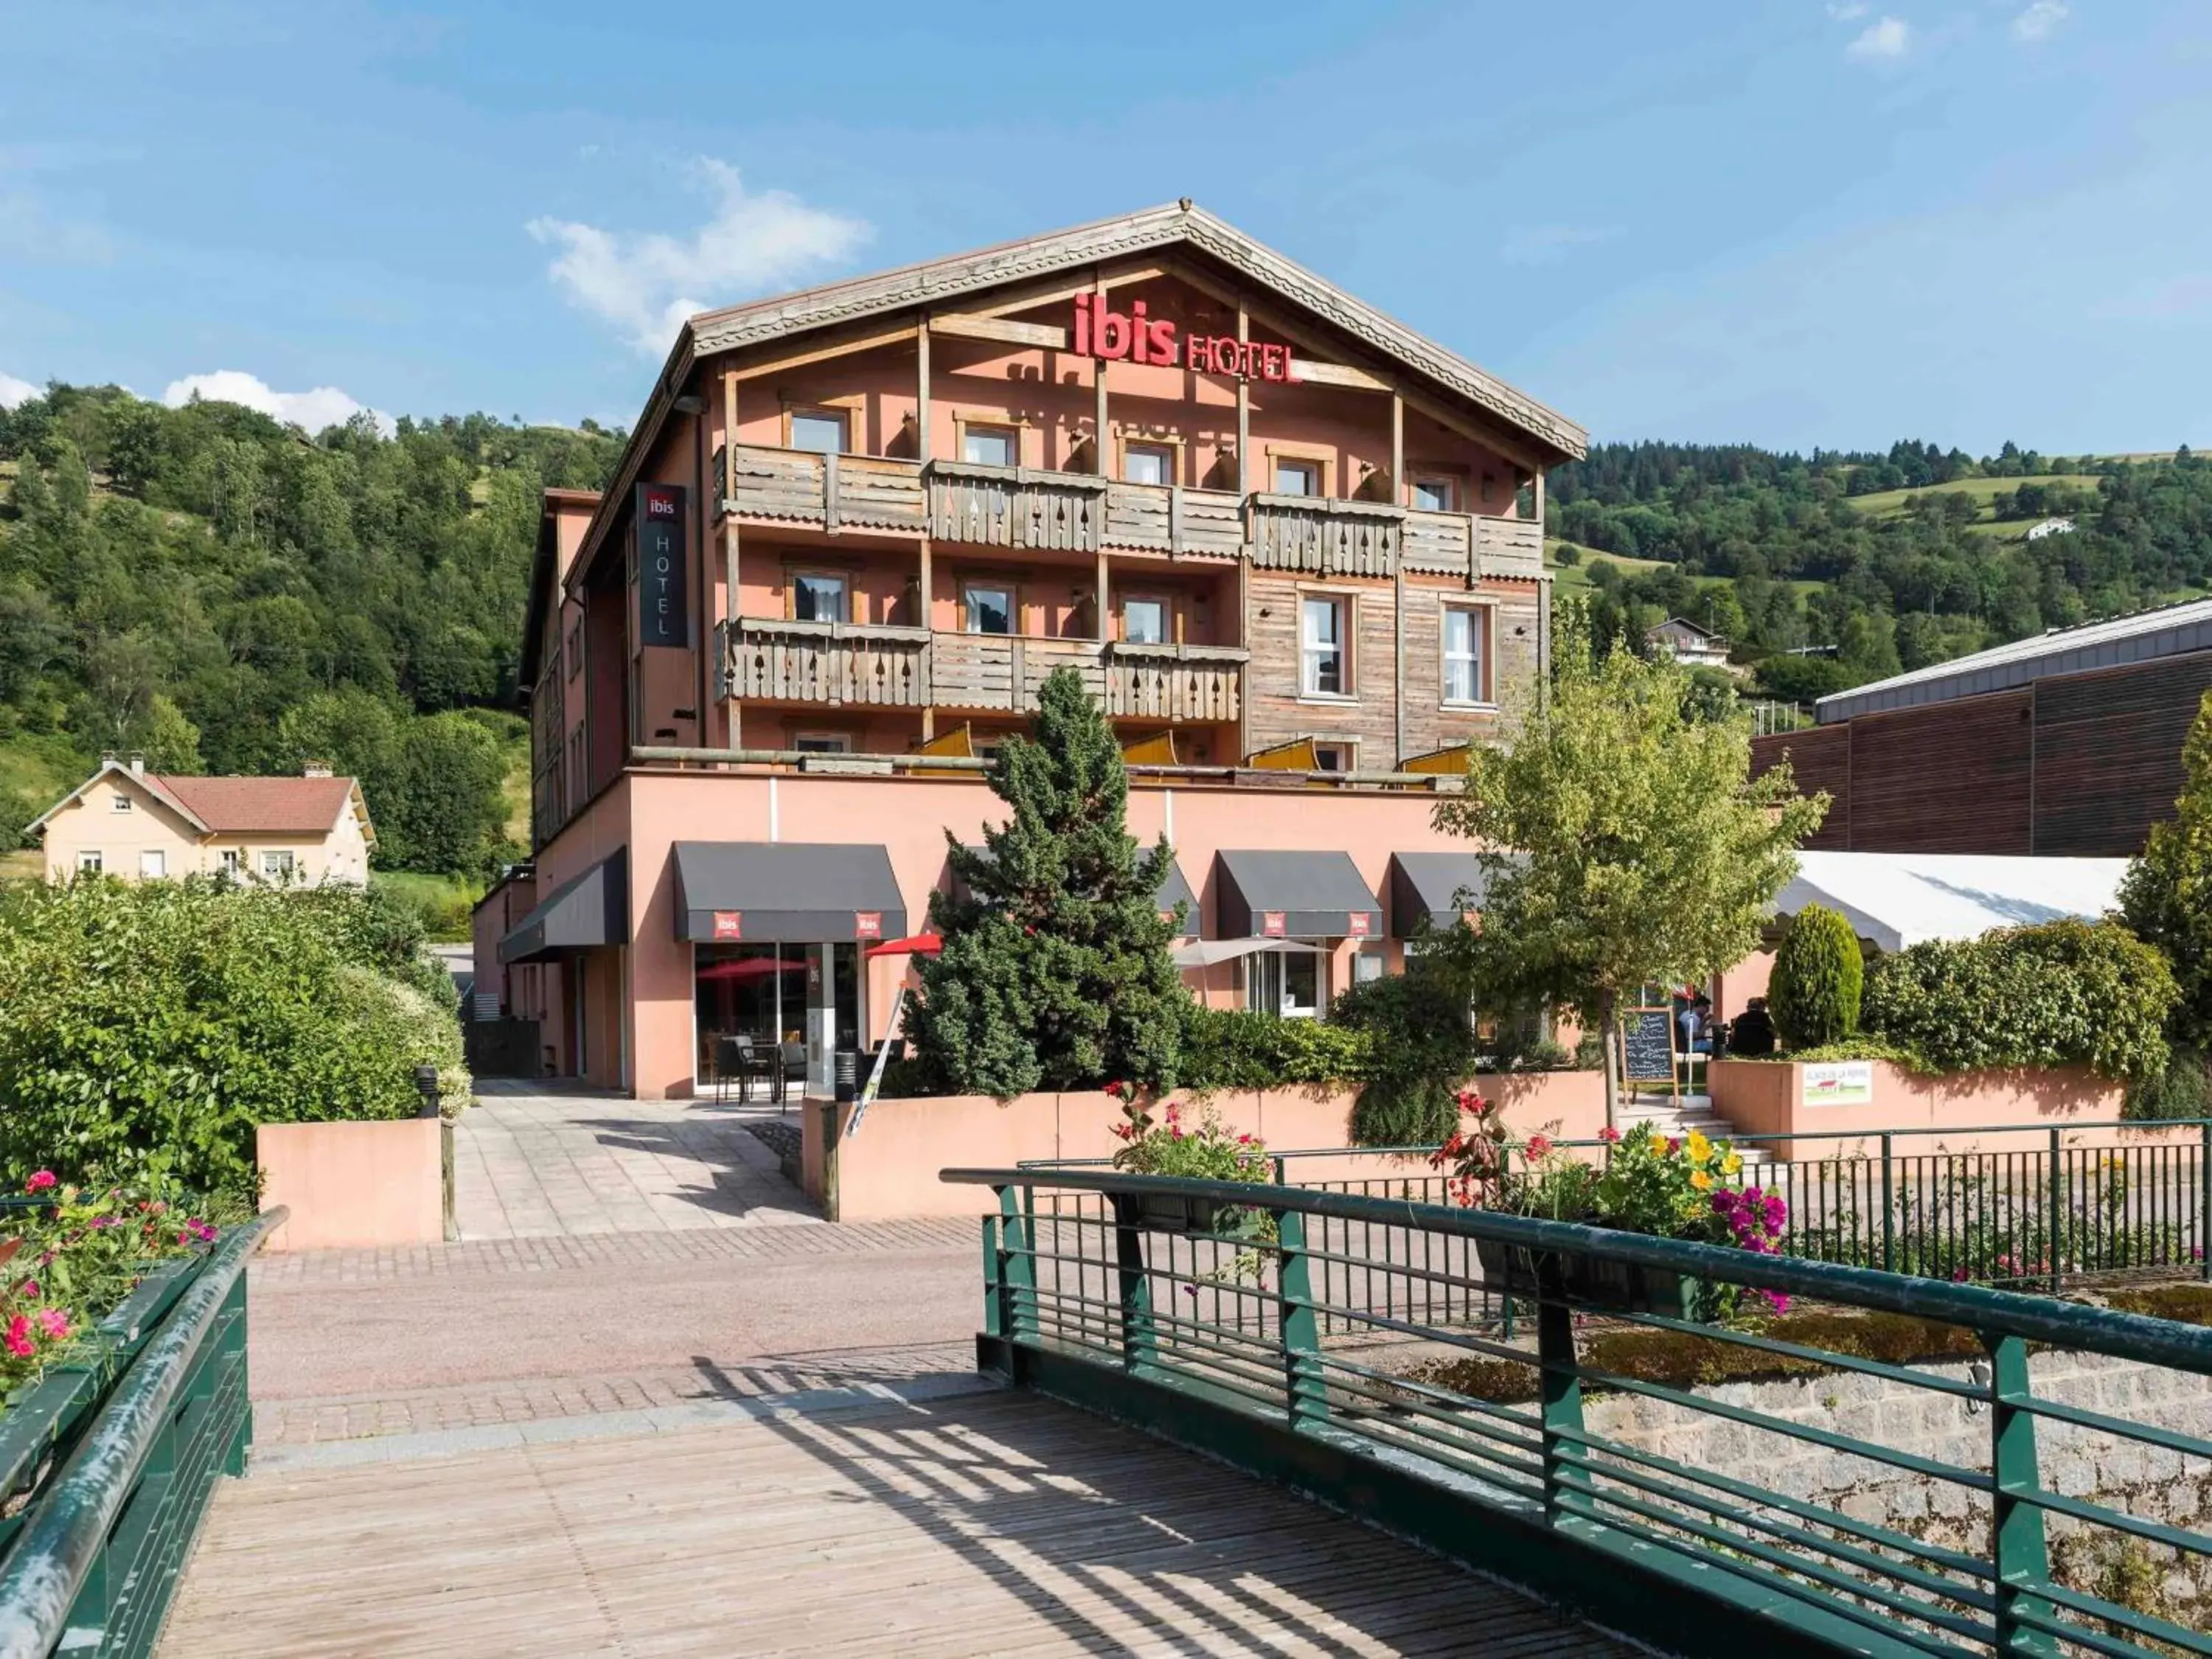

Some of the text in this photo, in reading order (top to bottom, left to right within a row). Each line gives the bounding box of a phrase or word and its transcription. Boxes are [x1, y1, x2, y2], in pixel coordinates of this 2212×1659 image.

[1074, 293, 1304, 384] ibis HOTEL
[650, 499, 675, 515] ibis
[656, 536, 669, 636] HOTEL
